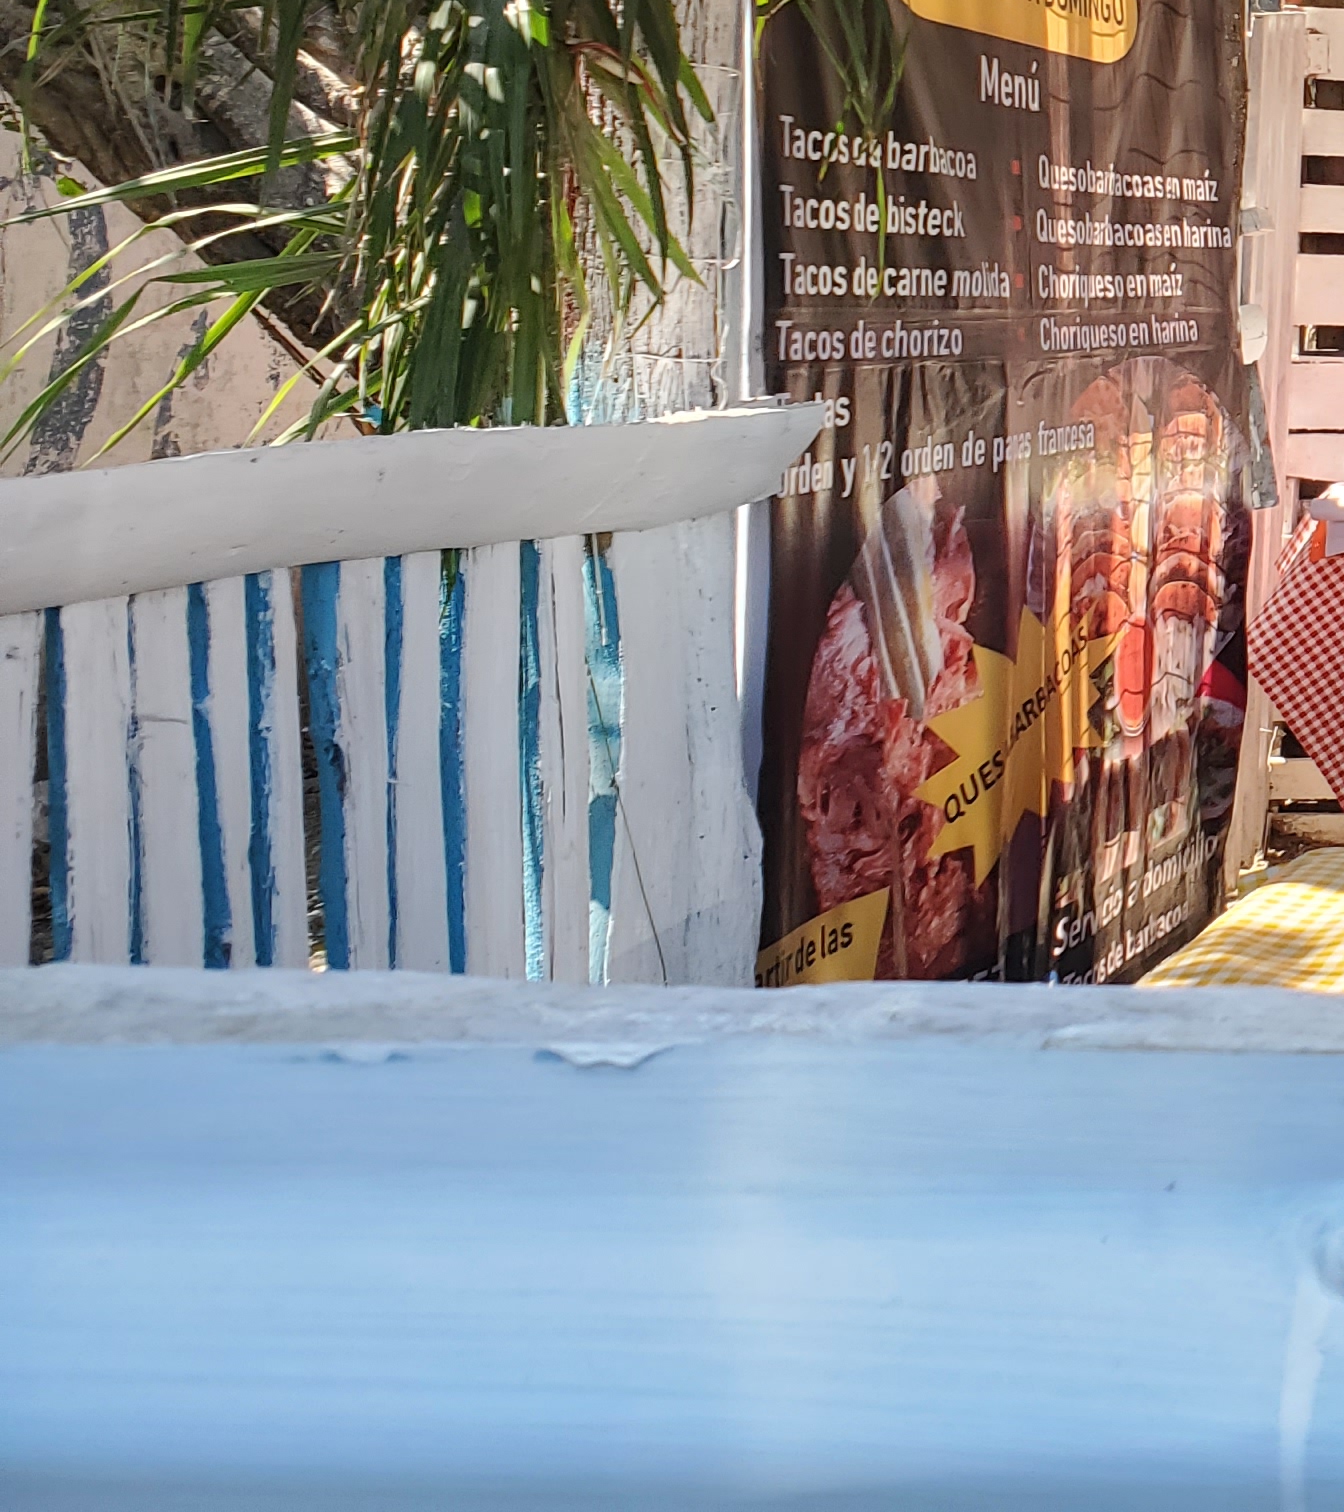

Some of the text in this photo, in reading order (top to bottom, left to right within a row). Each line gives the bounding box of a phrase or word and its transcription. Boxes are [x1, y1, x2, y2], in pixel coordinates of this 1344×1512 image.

[980, 54, 1041, 112] Menú
[778, 114, 849, 165] Tacos
[886, 130, 977, 180] barbacoa
[1038, 154, 1219, 202] Quesobarbacoas en maíz
[778, 184, 966, 238] Tacos de bisteck
[1036, 207, 1233, 249] Quesobarbacoas en harina
[778, 252, 1011, 298] Tacos de carne molida
[1038, 262, 1183, 309] Choriqueso en maíz
[775, 318, 963, 361] Tacos de chorizo
[1039, 312, 1199, 353] Choriqueso en harina
[840, 457, 857, 499] y
[862, 440, 894, 483] 1/2
[901, 435, 955, 477] orden
[961, 430, 986, 468] de
[1038, 420, 1095, 457] francesa
[1127, 879, 1139, 910] a
[1142, 829, 1219, 898] domicilio
[755, 921, 855, 988] artir de las
[1106, 937, 1124, 977] de
[1125, 899, 1190, 961] barbacoa
